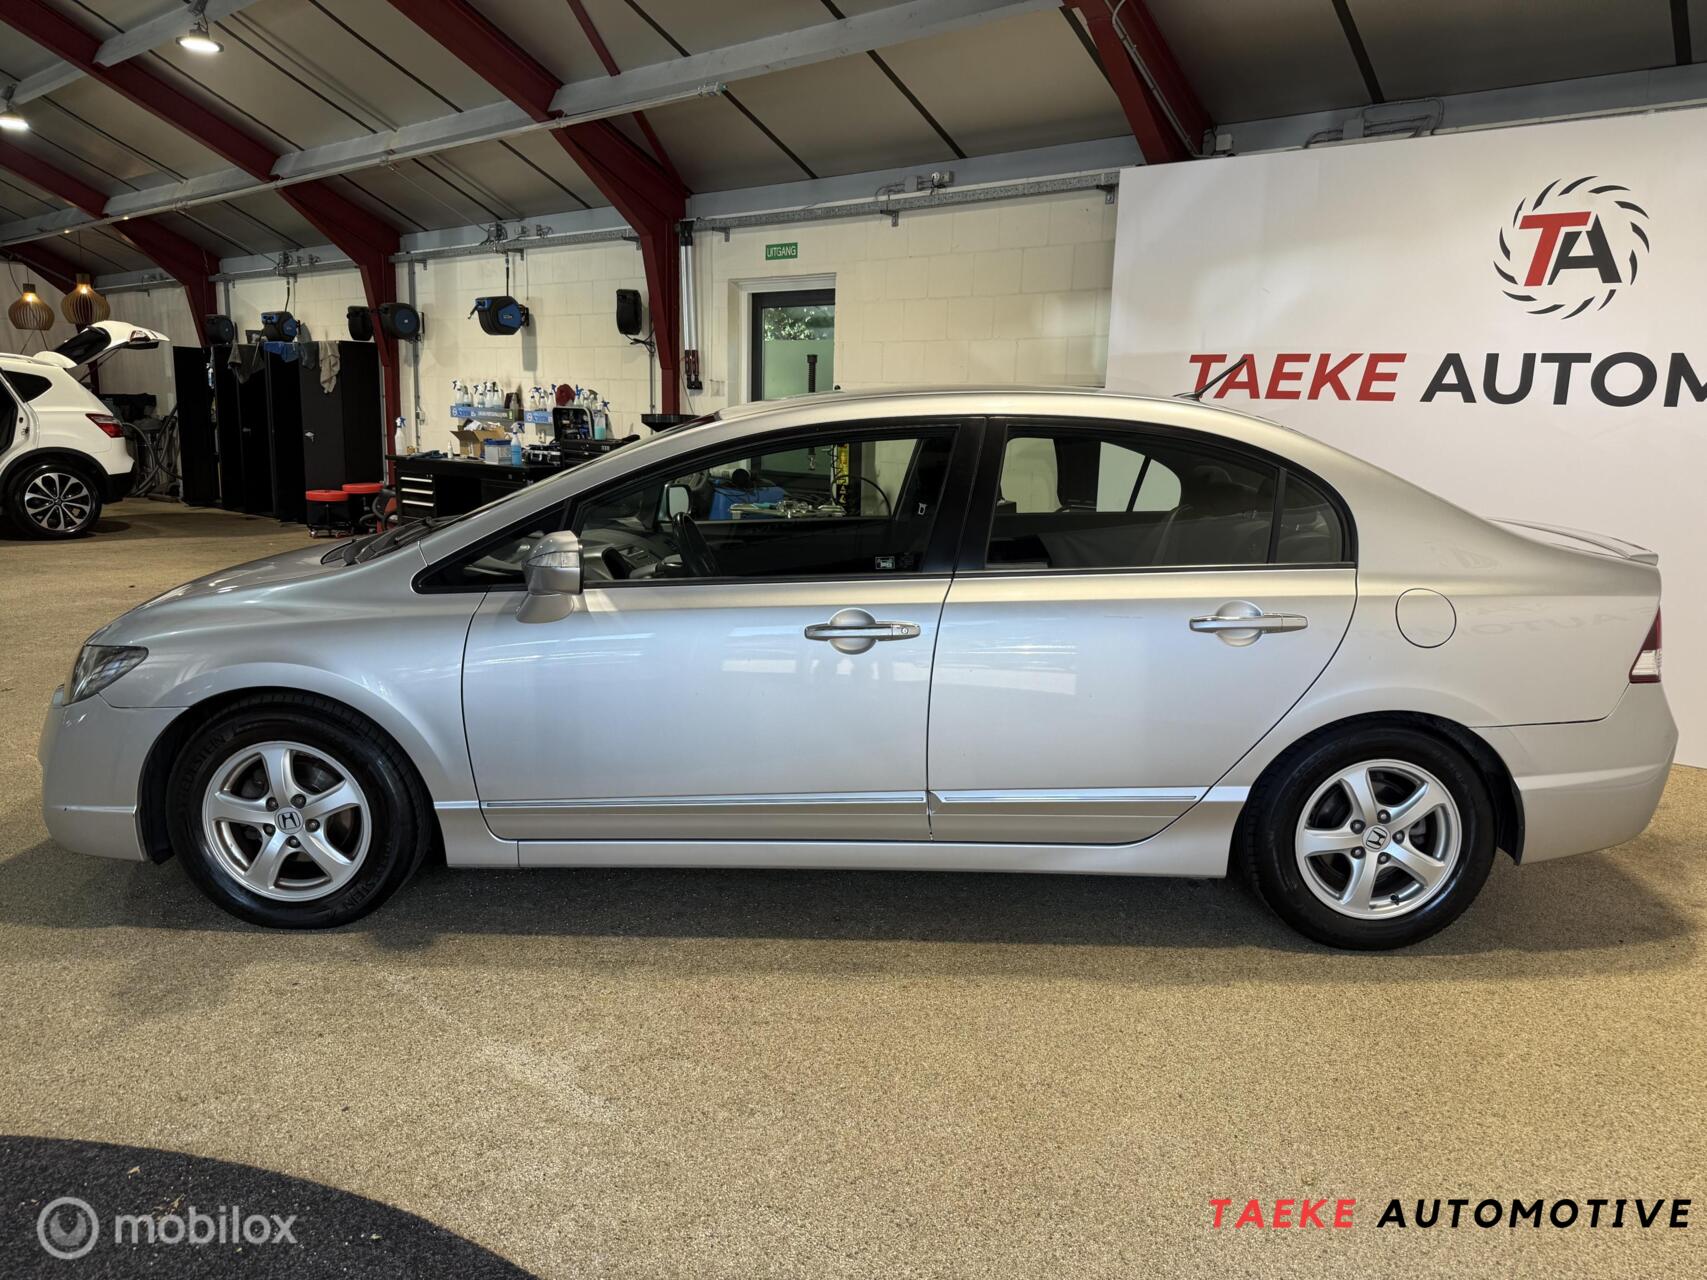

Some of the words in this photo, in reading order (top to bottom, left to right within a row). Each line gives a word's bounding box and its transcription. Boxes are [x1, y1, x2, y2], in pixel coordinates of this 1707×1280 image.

[767, 245, 796, 257] UITGANG
[1519, 211, 1622, 286] TA
[1189, 353, 1406, 401] TAEKE
